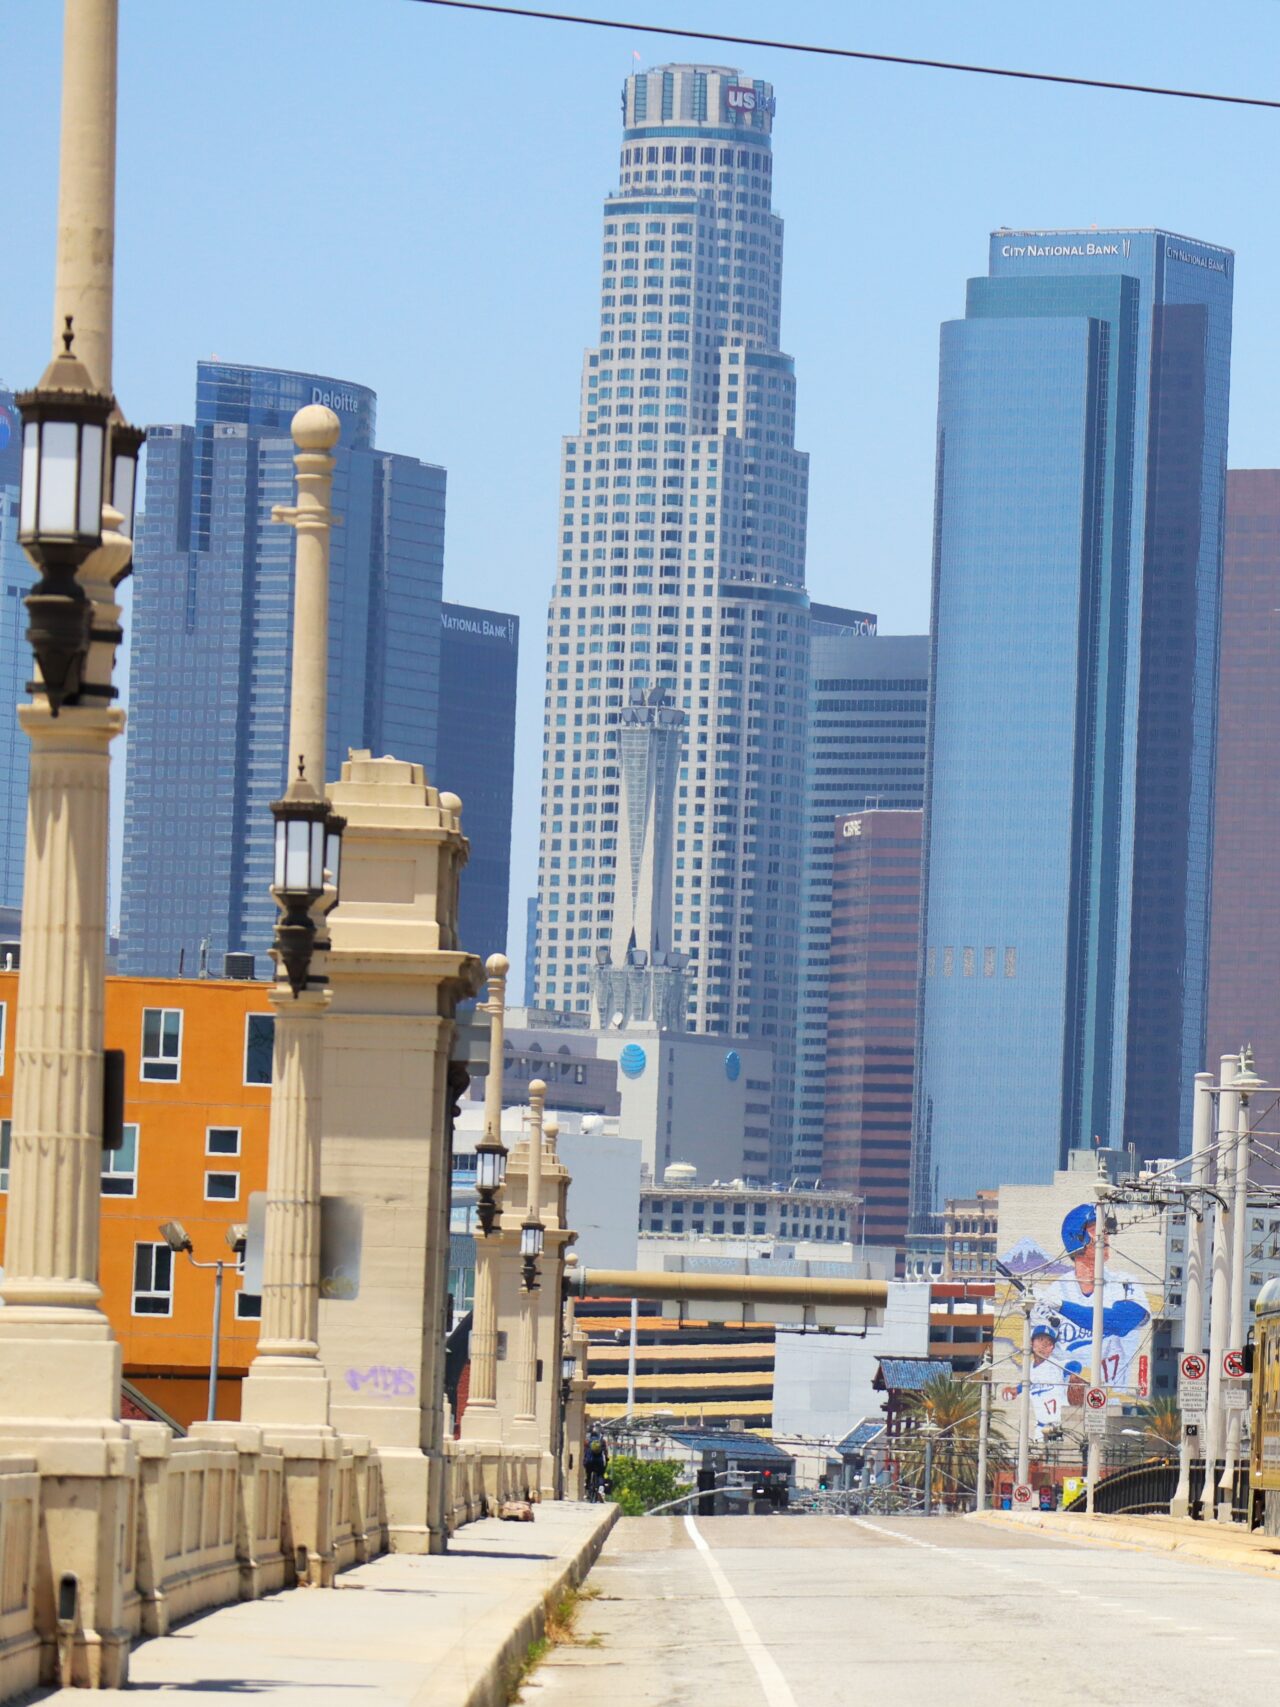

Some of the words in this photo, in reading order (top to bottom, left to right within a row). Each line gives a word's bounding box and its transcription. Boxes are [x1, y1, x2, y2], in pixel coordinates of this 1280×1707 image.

[311, 387, 359, 413] Deloitte
[1101, 1353, 1120, 1383] 17
[1043, 1398, 1057, 1415] 17
